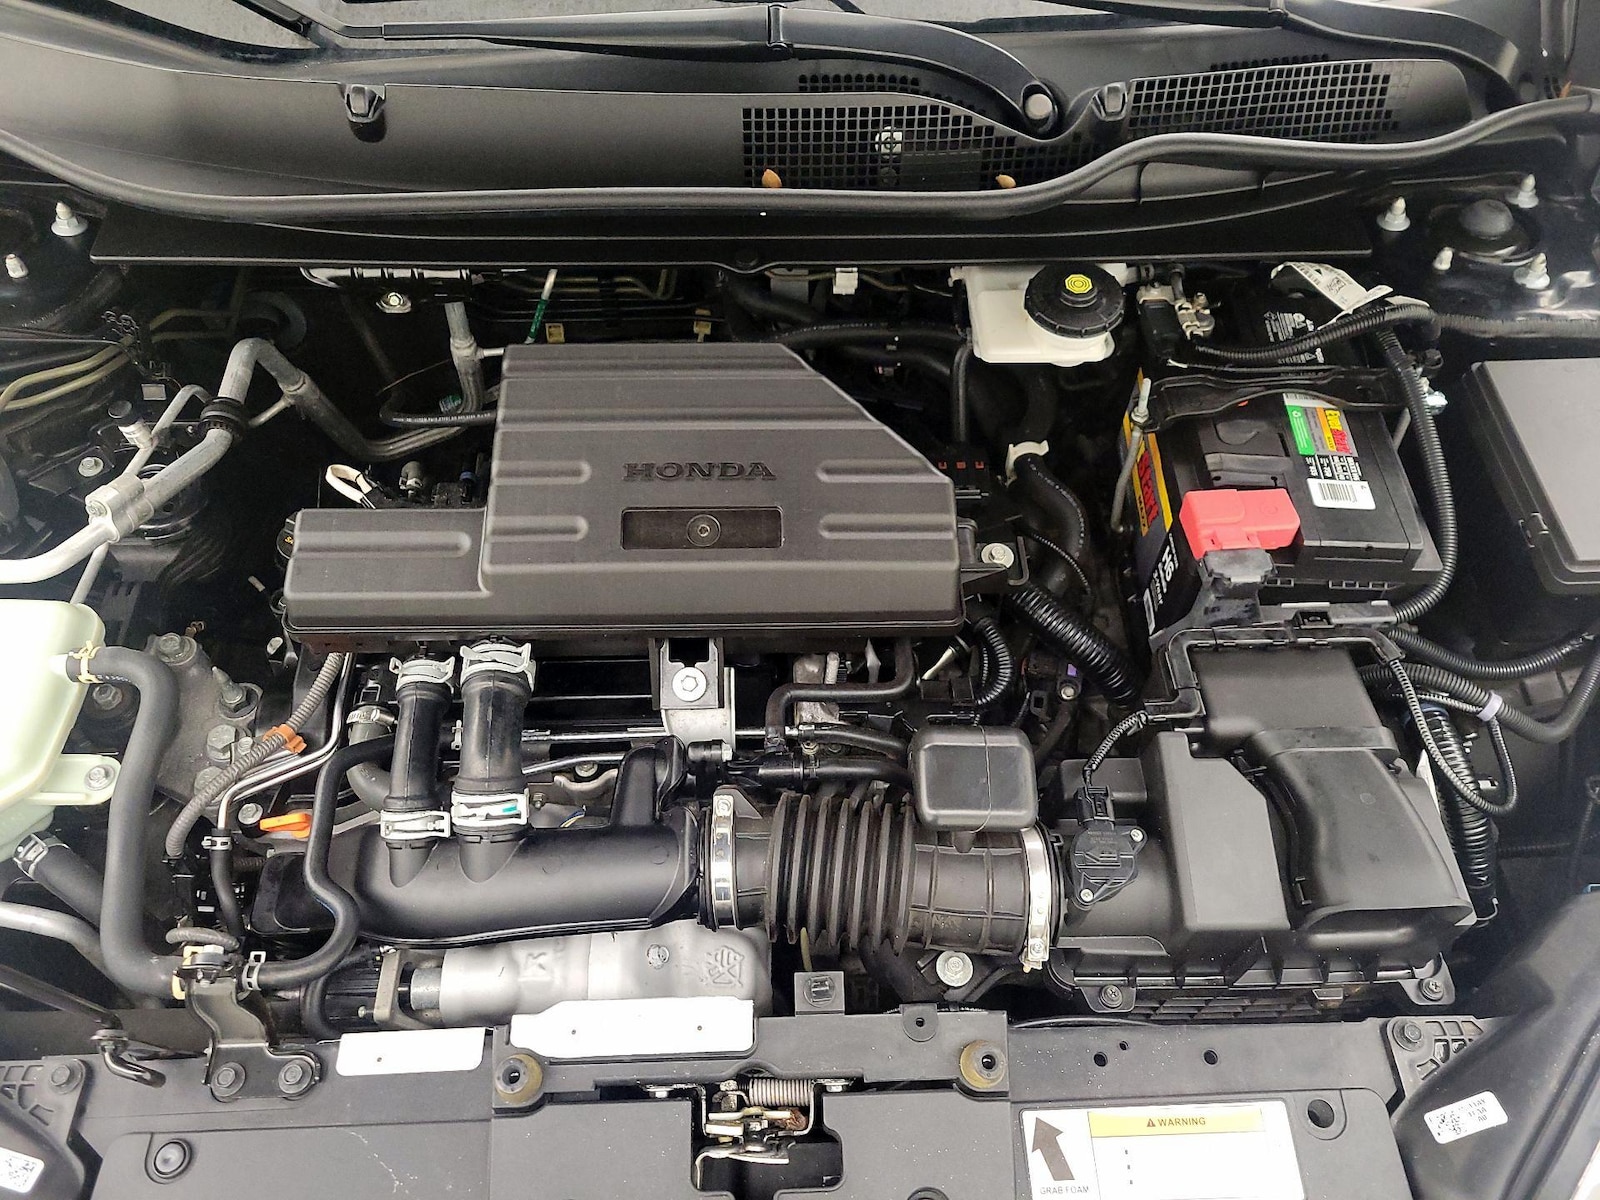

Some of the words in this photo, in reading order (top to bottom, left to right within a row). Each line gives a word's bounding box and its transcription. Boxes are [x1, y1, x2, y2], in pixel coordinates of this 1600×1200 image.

[622, 462, 777, 481] HONDA
[1162, 545, 1174, 582] H6
[1157, 1116, 1206, 1127] WARNING
[1040, 1186, 1063, 1195] GRAB
[1065, 1185, 1089, 1194] FOAM
